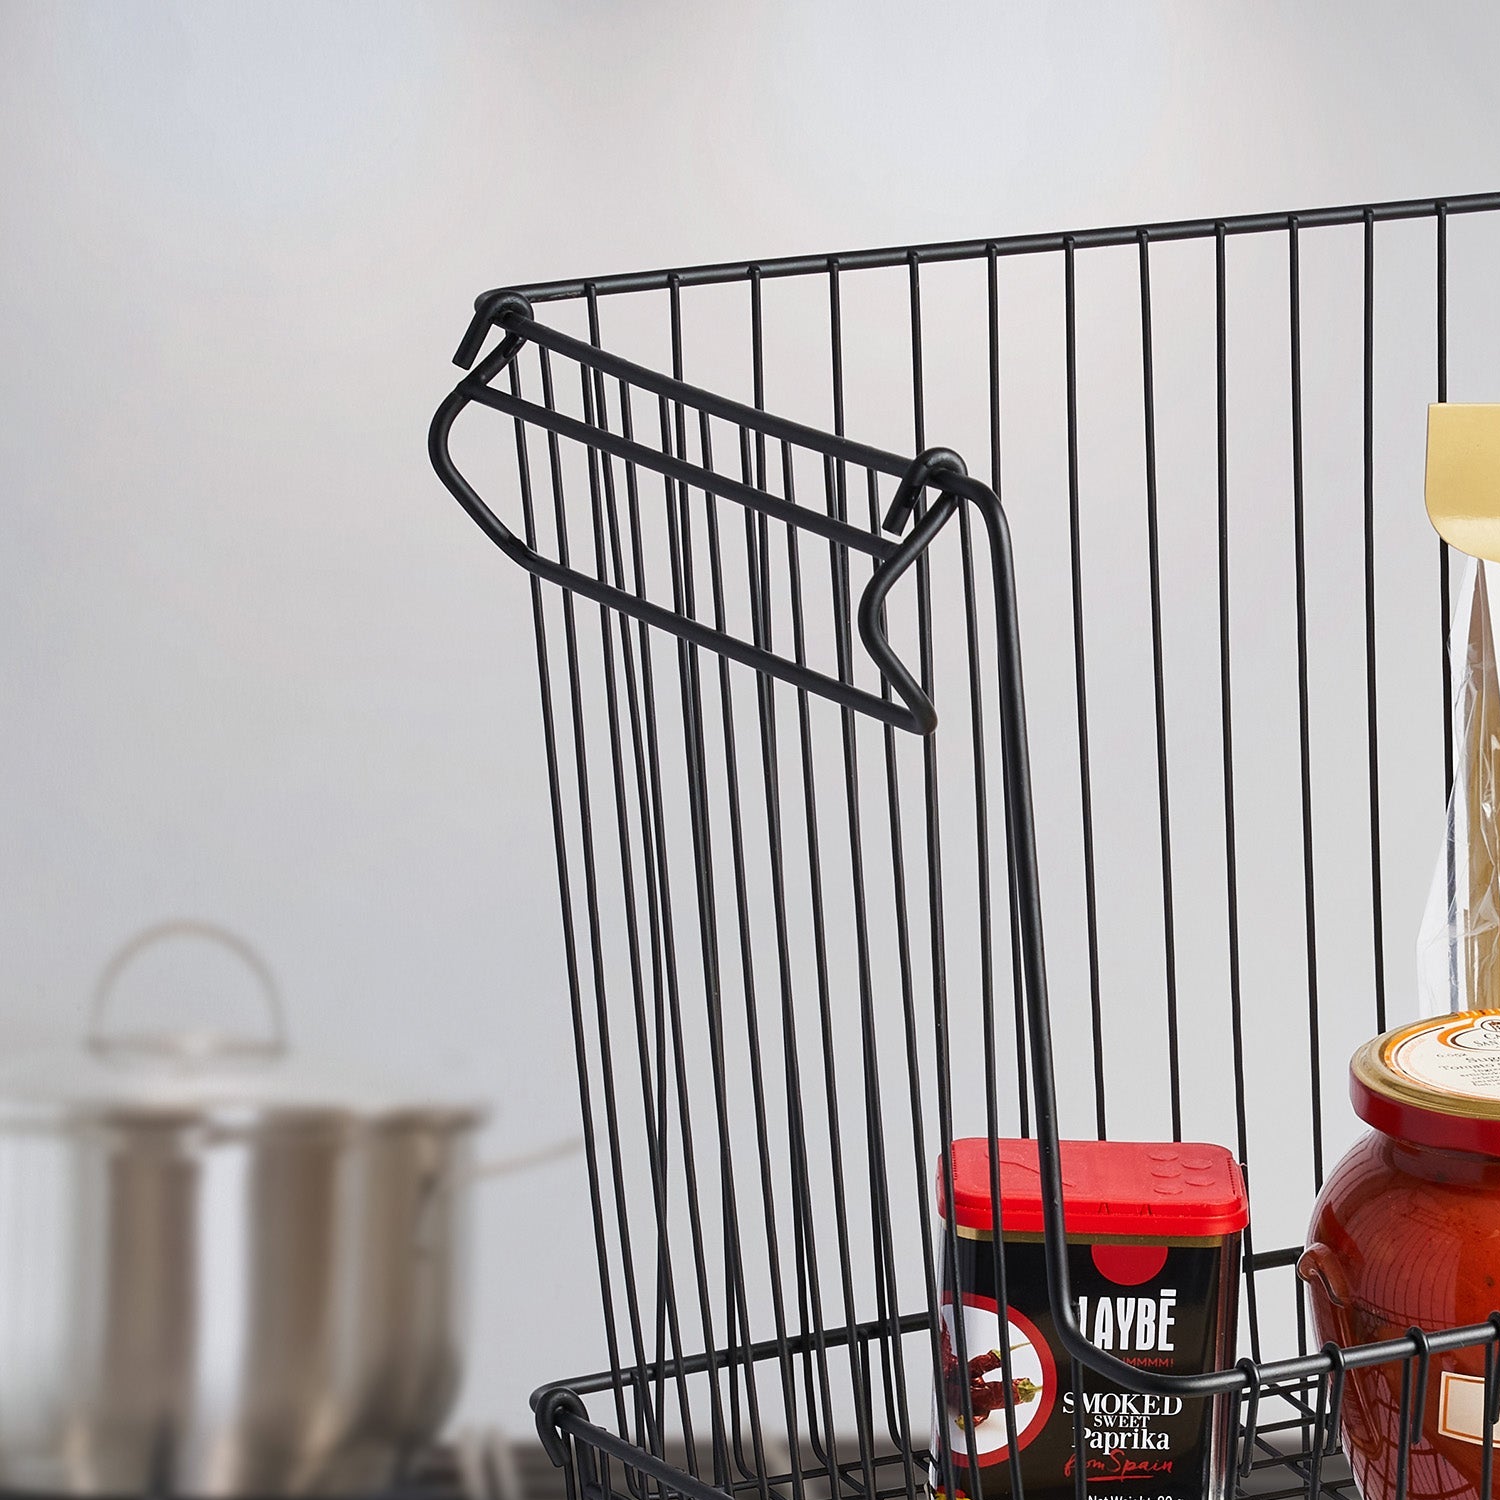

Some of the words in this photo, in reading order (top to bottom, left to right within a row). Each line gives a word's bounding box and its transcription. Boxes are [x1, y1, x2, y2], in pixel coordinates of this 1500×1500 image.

[1062, 1391, 1183, 1416] SMOKED
[1093, 1415, 1150, 1428] SWEET
[1063, 1455, 1106, 1477] fom
[1109, 1448, 1174, 1482] Spain
